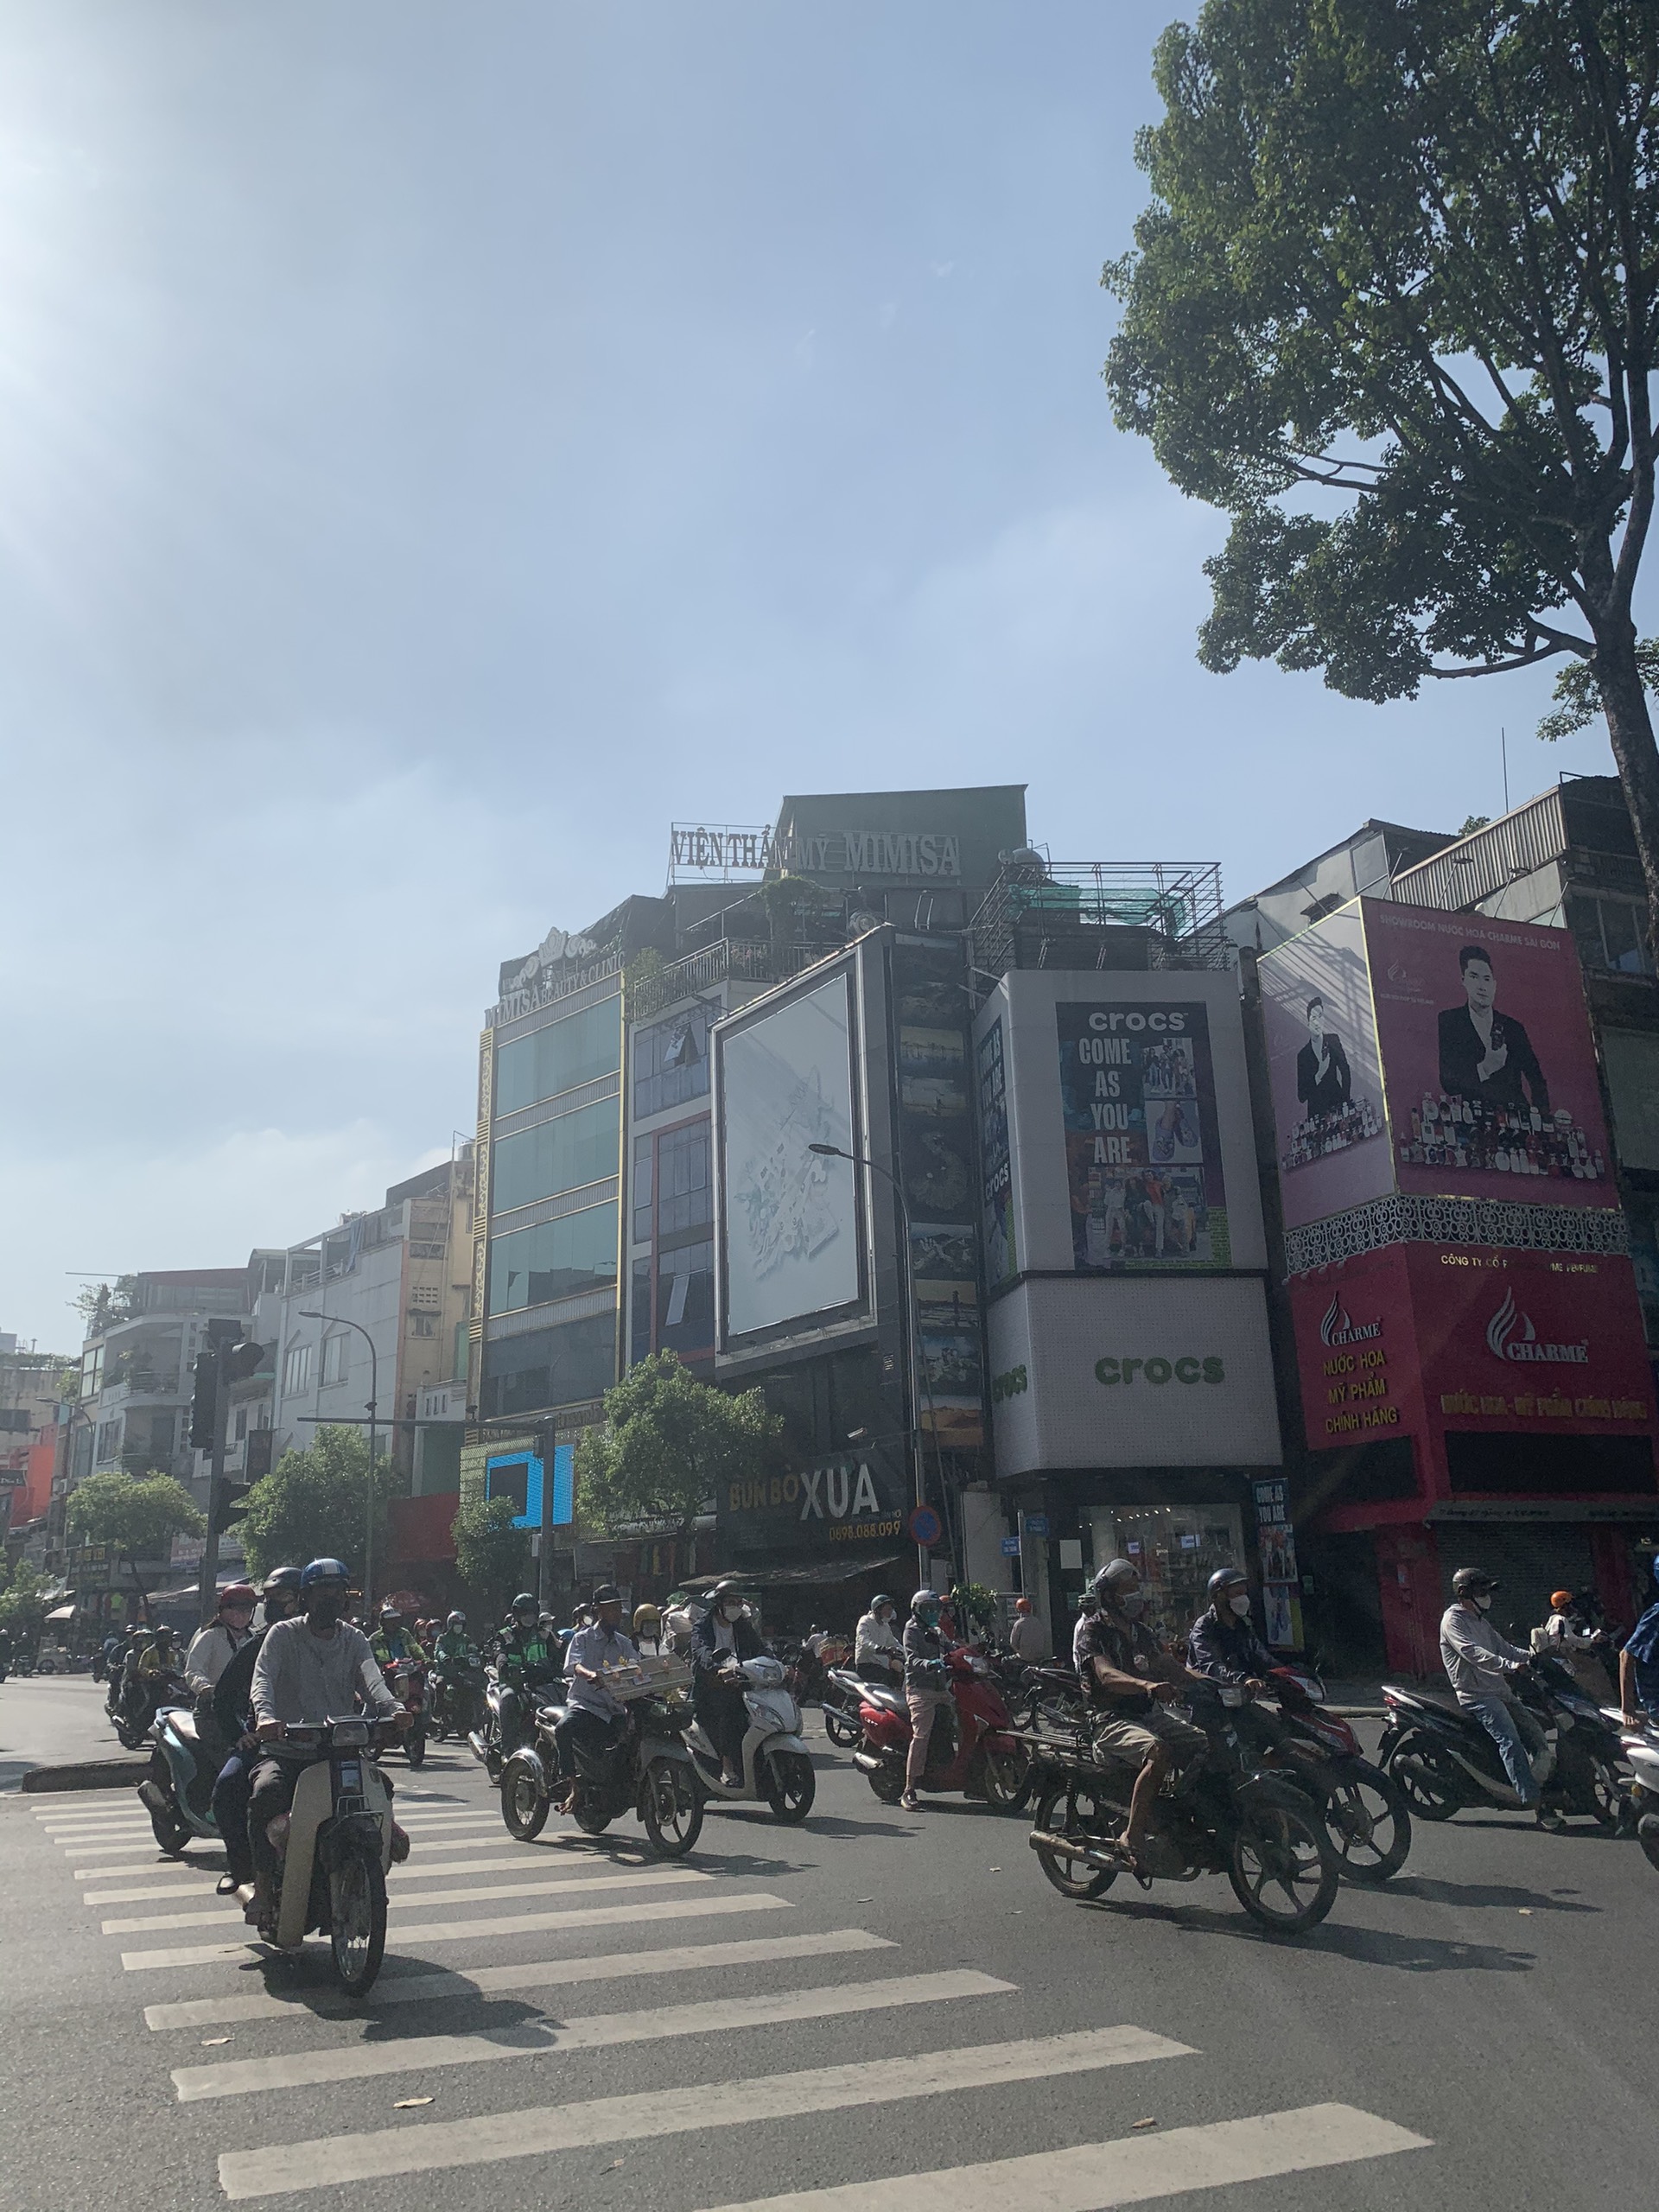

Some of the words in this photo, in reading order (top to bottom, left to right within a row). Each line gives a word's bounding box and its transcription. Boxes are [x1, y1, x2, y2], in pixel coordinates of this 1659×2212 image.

[843, 832, 961, 876] MIMISA
[1465, 927, 1486, 939] HOA
[485, 984, 541, 1027] MIMISA
[542, 973, 580, 1005] BEAUTY
[580, 969, 588, 987] &
[588, 951, 625, 983] CLINIC
[1078, 1038, 1132, 1065] COME
[1095, 1071, 1121, 1097] AS
[1090, 1103, 1129, 1131] YOU
[1093, 1136, 1133, 1165] ARE
[985, 1162, 1009, 1201] crocs
[1441, 1253, 1469, 1267] CÔNG
[1472, 1258, 1482, 1268] TY
[1332, 1322, 1381, 1346] CHARME
[1360, 1349, 1385, 1369] HOA
[1507, 1342, 1588, 1363] CHARME
[1094, 1356, 1224, 1386] crocs
[1328, 1382, 1345, 1404] MỸ
